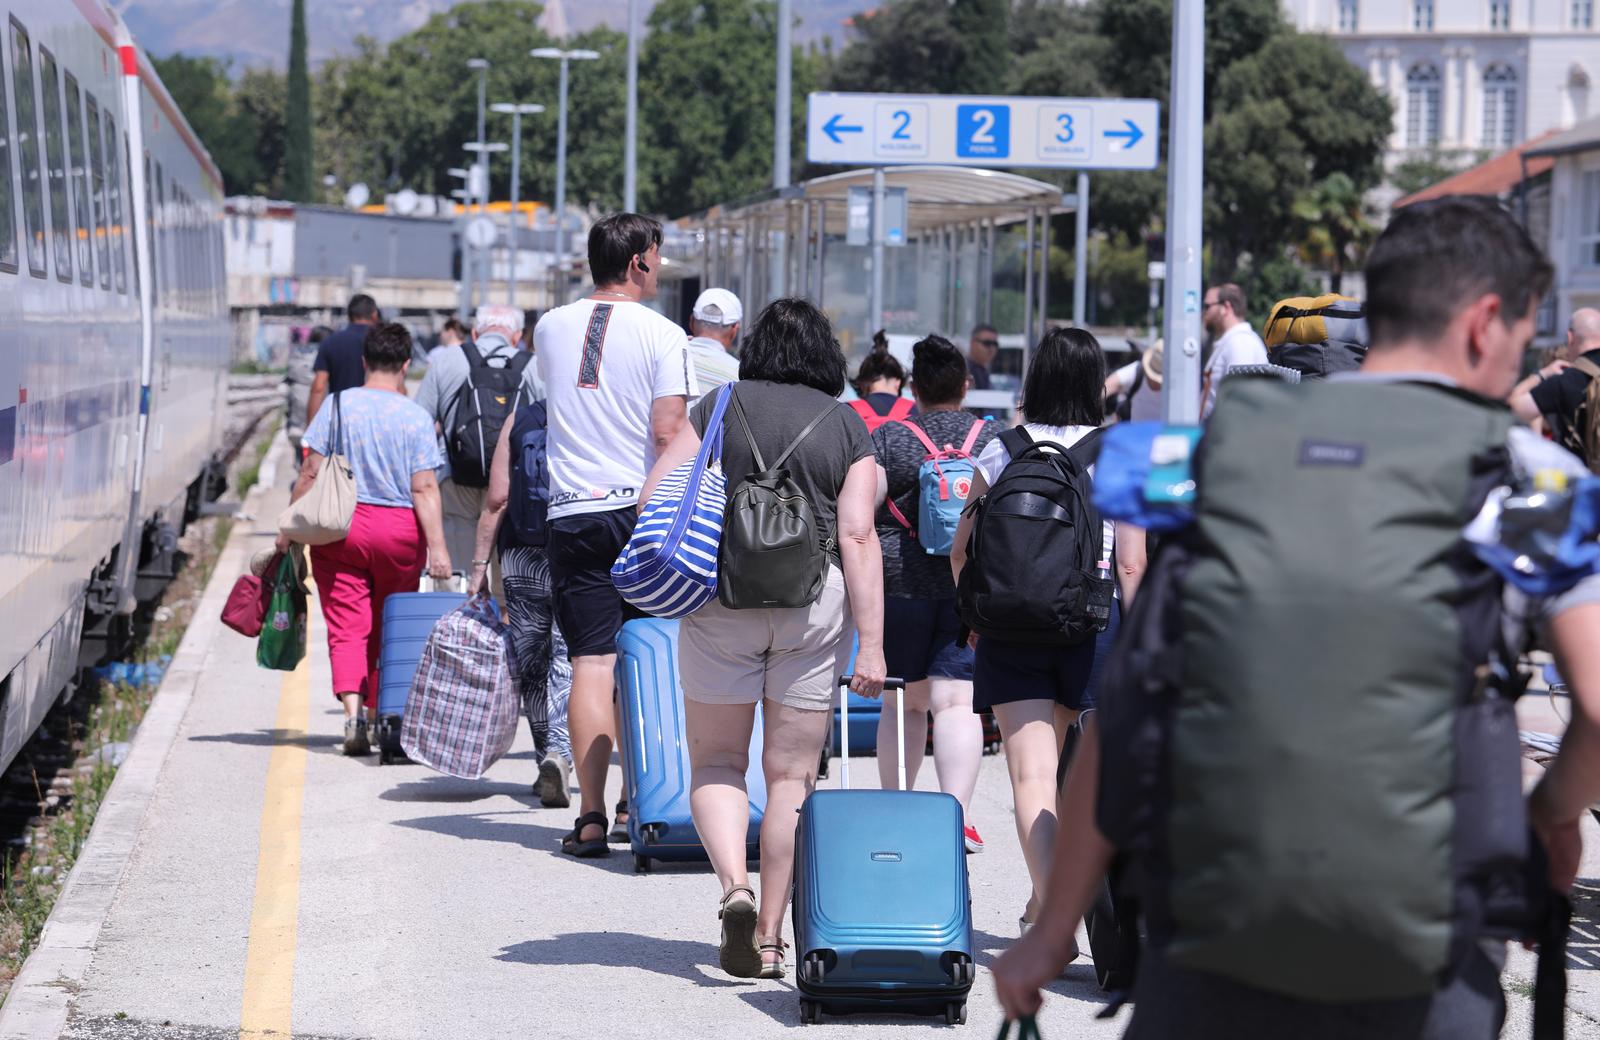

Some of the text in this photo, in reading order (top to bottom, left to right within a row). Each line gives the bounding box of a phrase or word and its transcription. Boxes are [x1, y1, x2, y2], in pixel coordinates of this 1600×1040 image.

[892, 109, 1073, 143] 2 2 3
